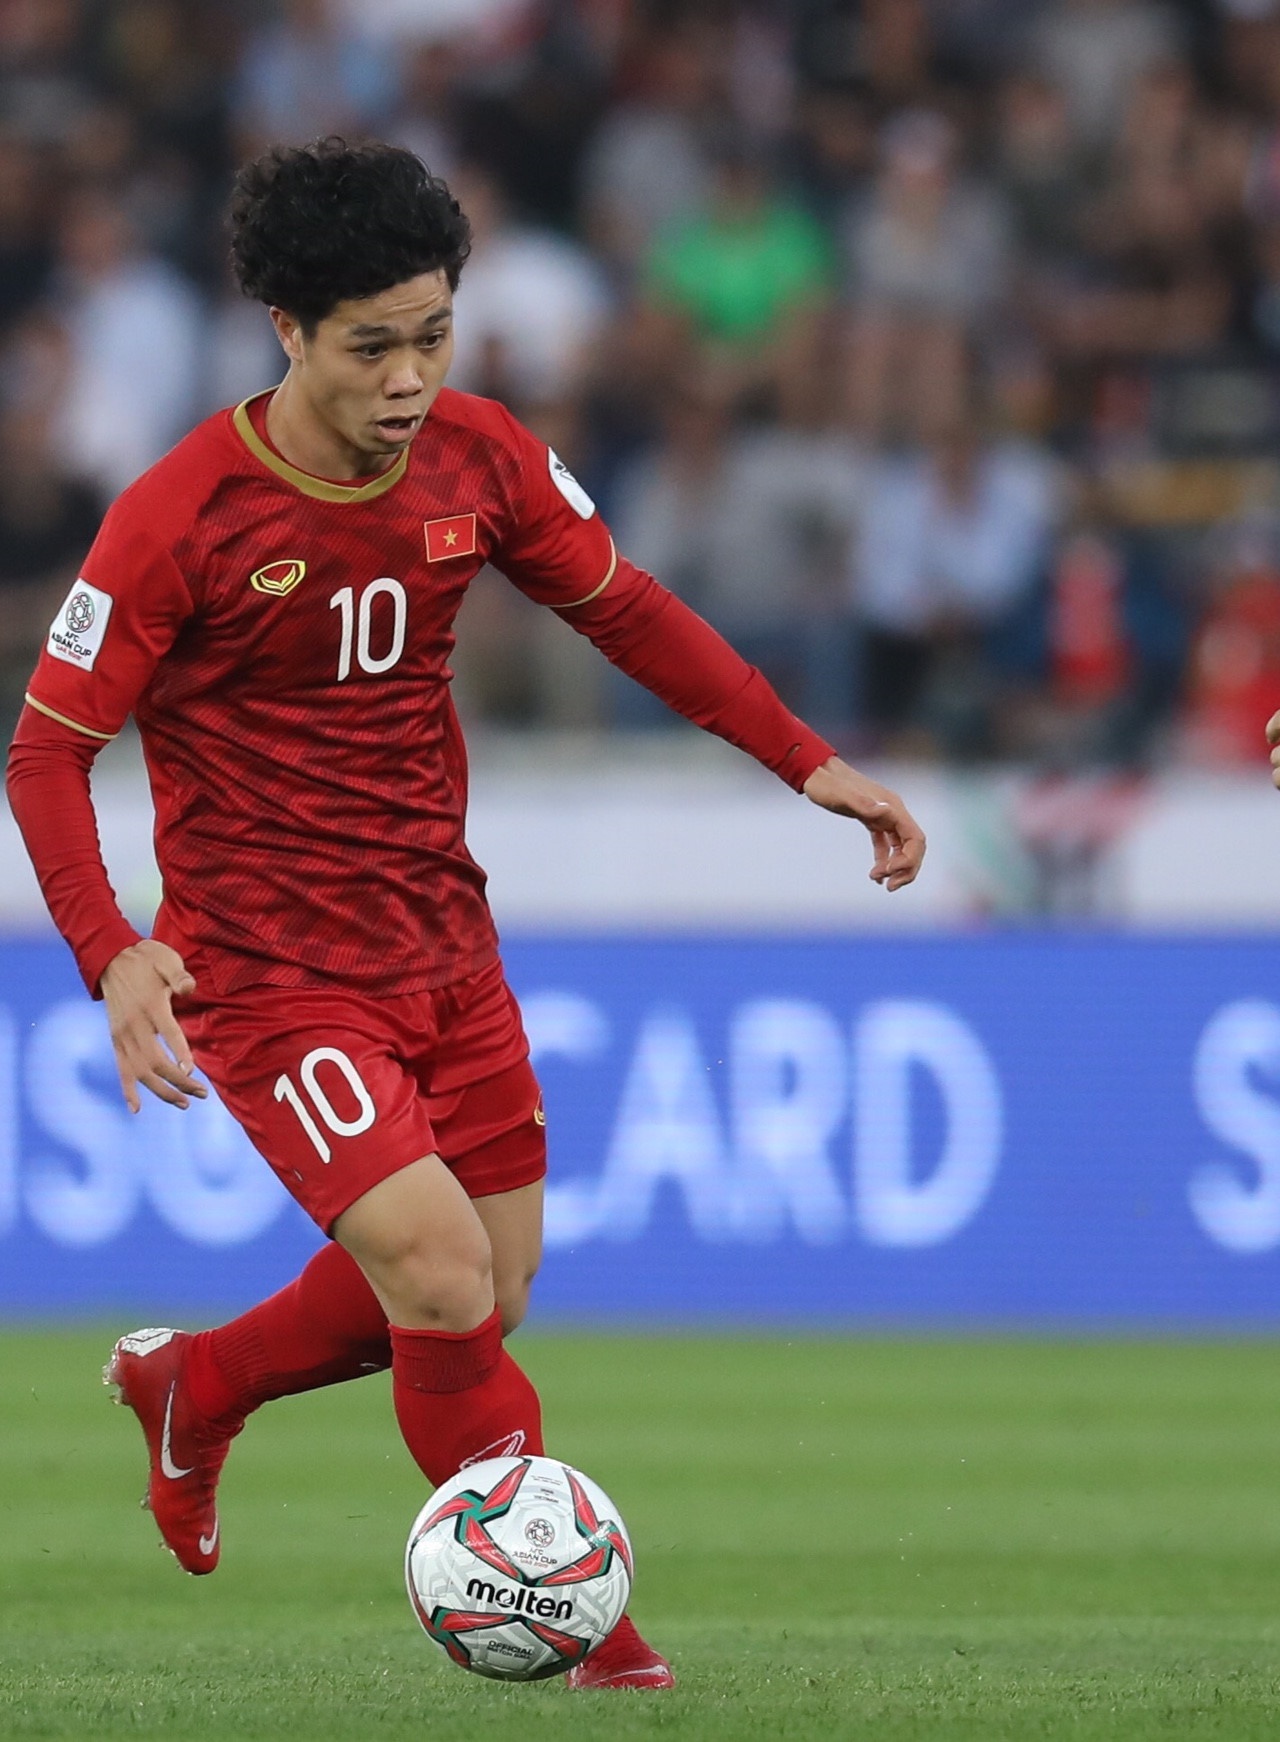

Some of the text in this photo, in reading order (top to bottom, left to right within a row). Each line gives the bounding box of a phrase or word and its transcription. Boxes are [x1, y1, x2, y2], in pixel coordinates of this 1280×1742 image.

[73, 644, 92, 656] CUP
[329, 577, 407, 682] 10
[273, 1046, 376, 1164] 10
[466, 1578, 573, 1620] molten
[488, 1640, 533, 1656] OFFICIAL
